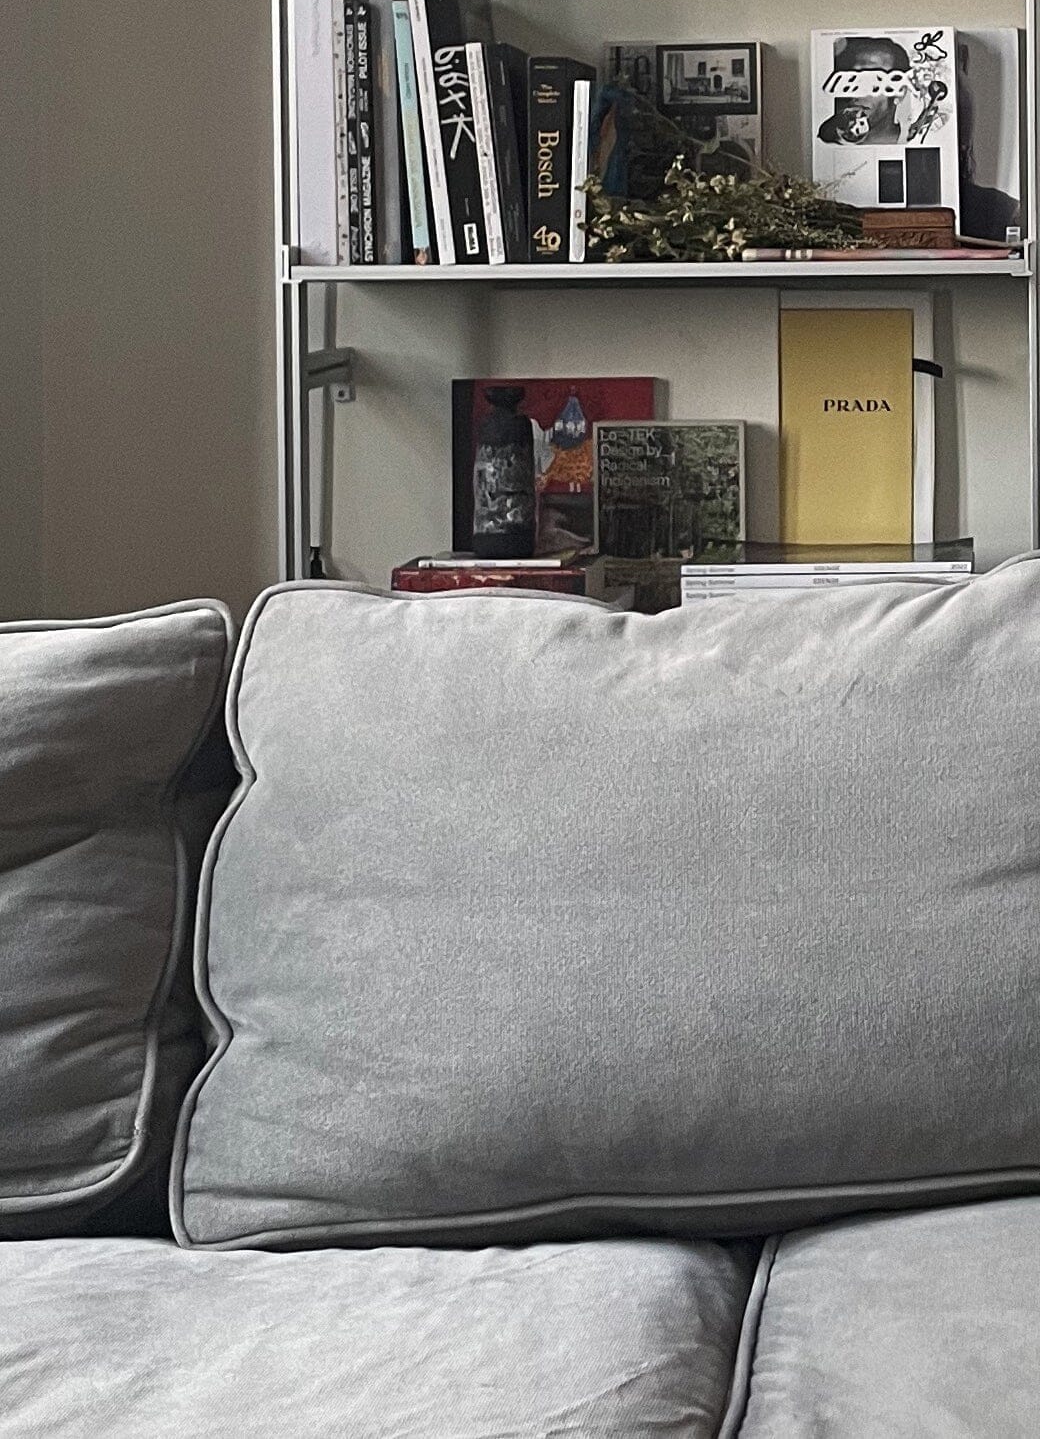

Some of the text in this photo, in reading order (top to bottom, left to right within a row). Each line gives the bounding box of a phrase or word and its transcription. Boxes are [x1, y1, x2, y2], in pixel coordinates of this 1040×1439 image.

[537, 129, 560, 198] Bosch
[823, 398, 892, 412] PRADA
[646, 443, 662, 458] by
